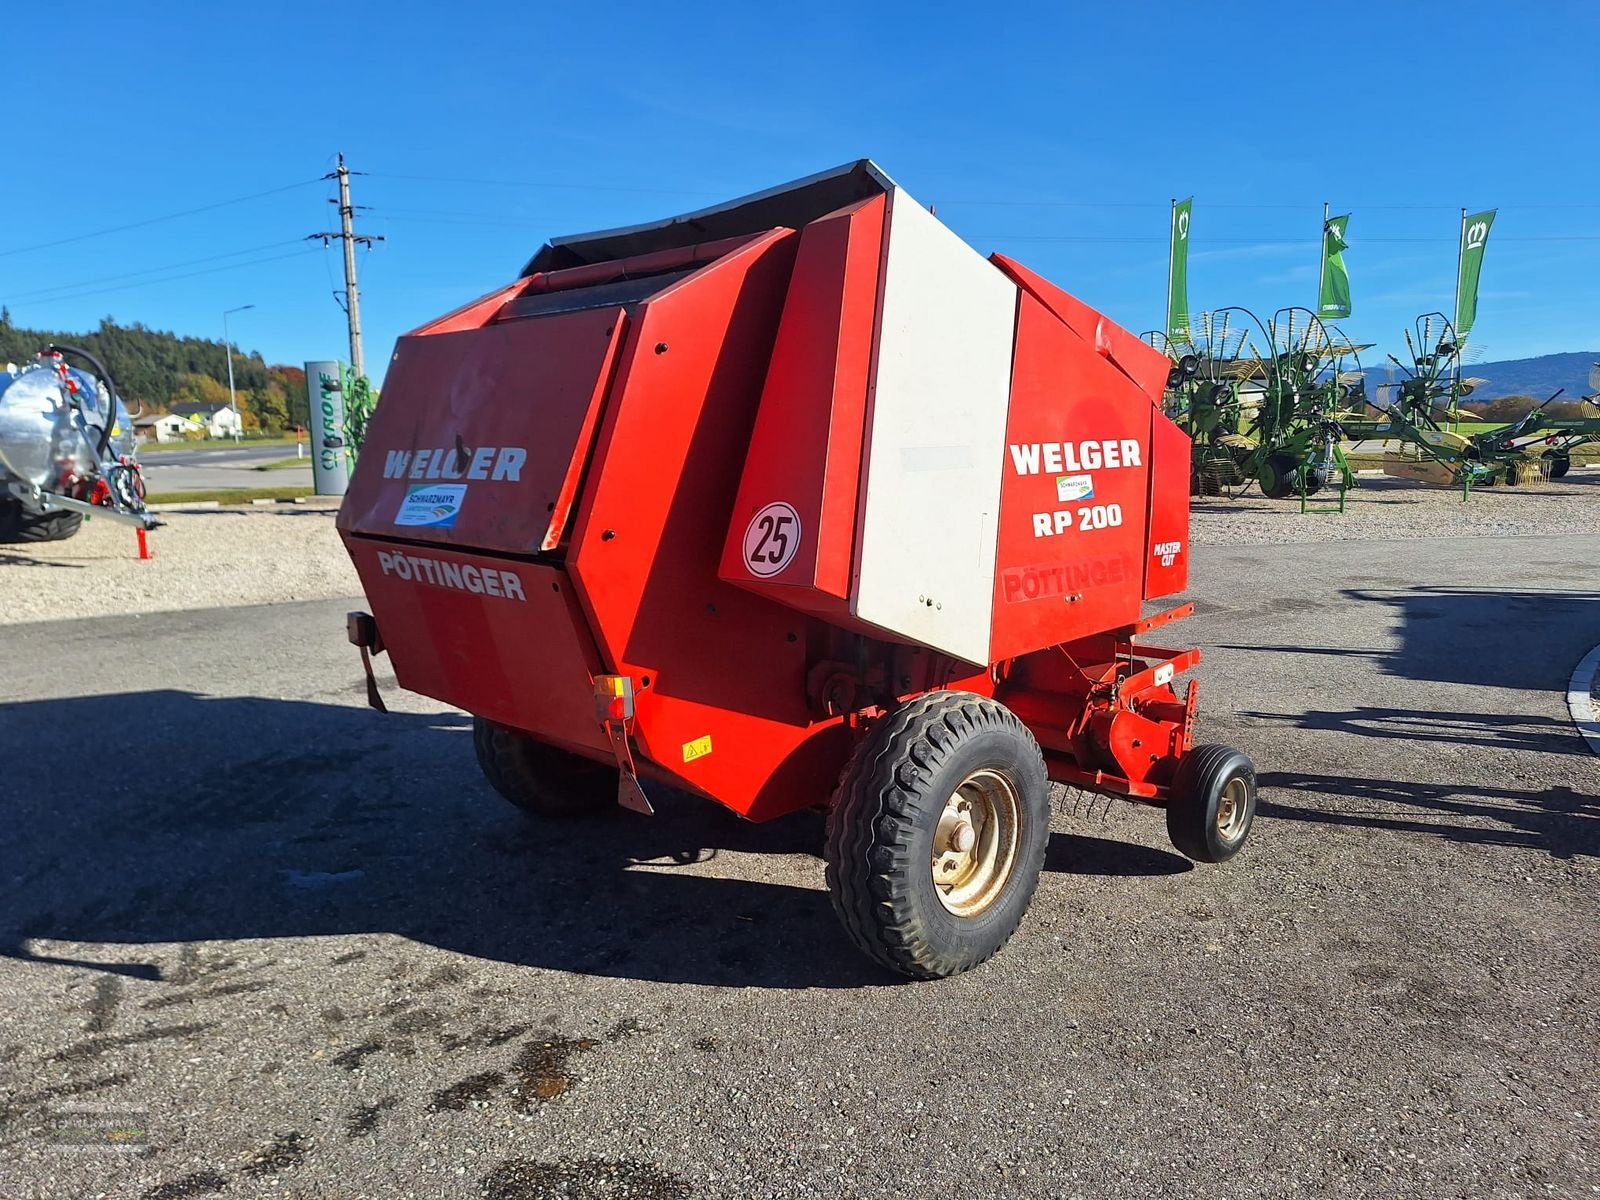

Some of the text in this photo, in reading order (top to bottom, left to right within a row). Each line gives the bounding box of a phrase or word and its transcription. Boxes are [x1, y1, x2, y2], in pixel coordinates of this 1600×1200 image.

[1010, 439, 1142, 476] WELGER
[1032, 503, 1123, 538] RP 200
[750, 515, 793, 564] 25
[1153, 541, 1181, 557] MASTER
[376, 550, 527, 602] PÖTTINGER
[1161, 554, 1175, 567] CUT
